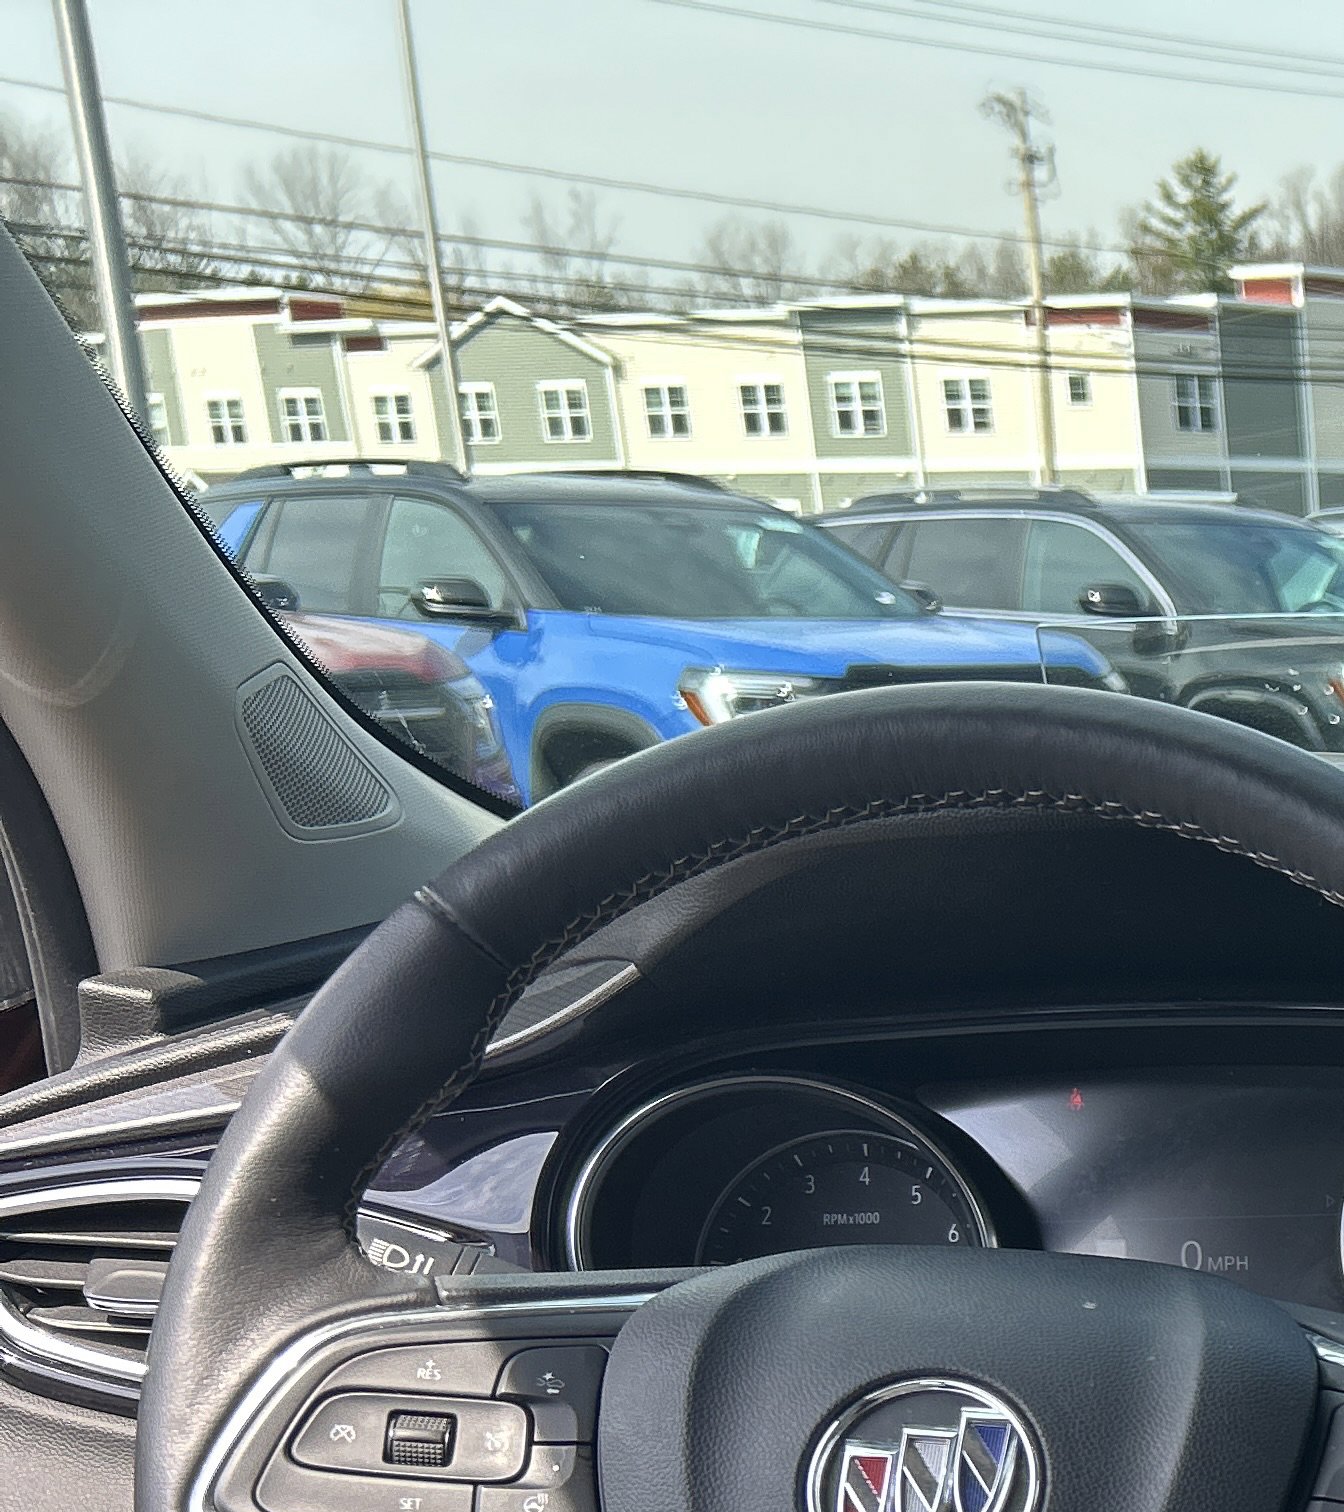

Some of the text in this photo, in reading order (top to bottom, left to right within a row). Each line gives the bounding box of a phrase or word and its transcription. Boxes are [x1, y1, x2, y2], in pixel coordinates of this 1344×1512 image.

[804, 1175, 816, 1195] 3
[859, 1167, 871, 1186] 4
[910, 1185, 922, 1205] 5
[760, 1206, 772, 1226] 2
[948, 1223, 960, 1244] 6
[1181, 1240, 1249, 1272] 0 MPH
[416, 1368, 442, 1380] RES
[400, 1498, 423, 1510] SET
